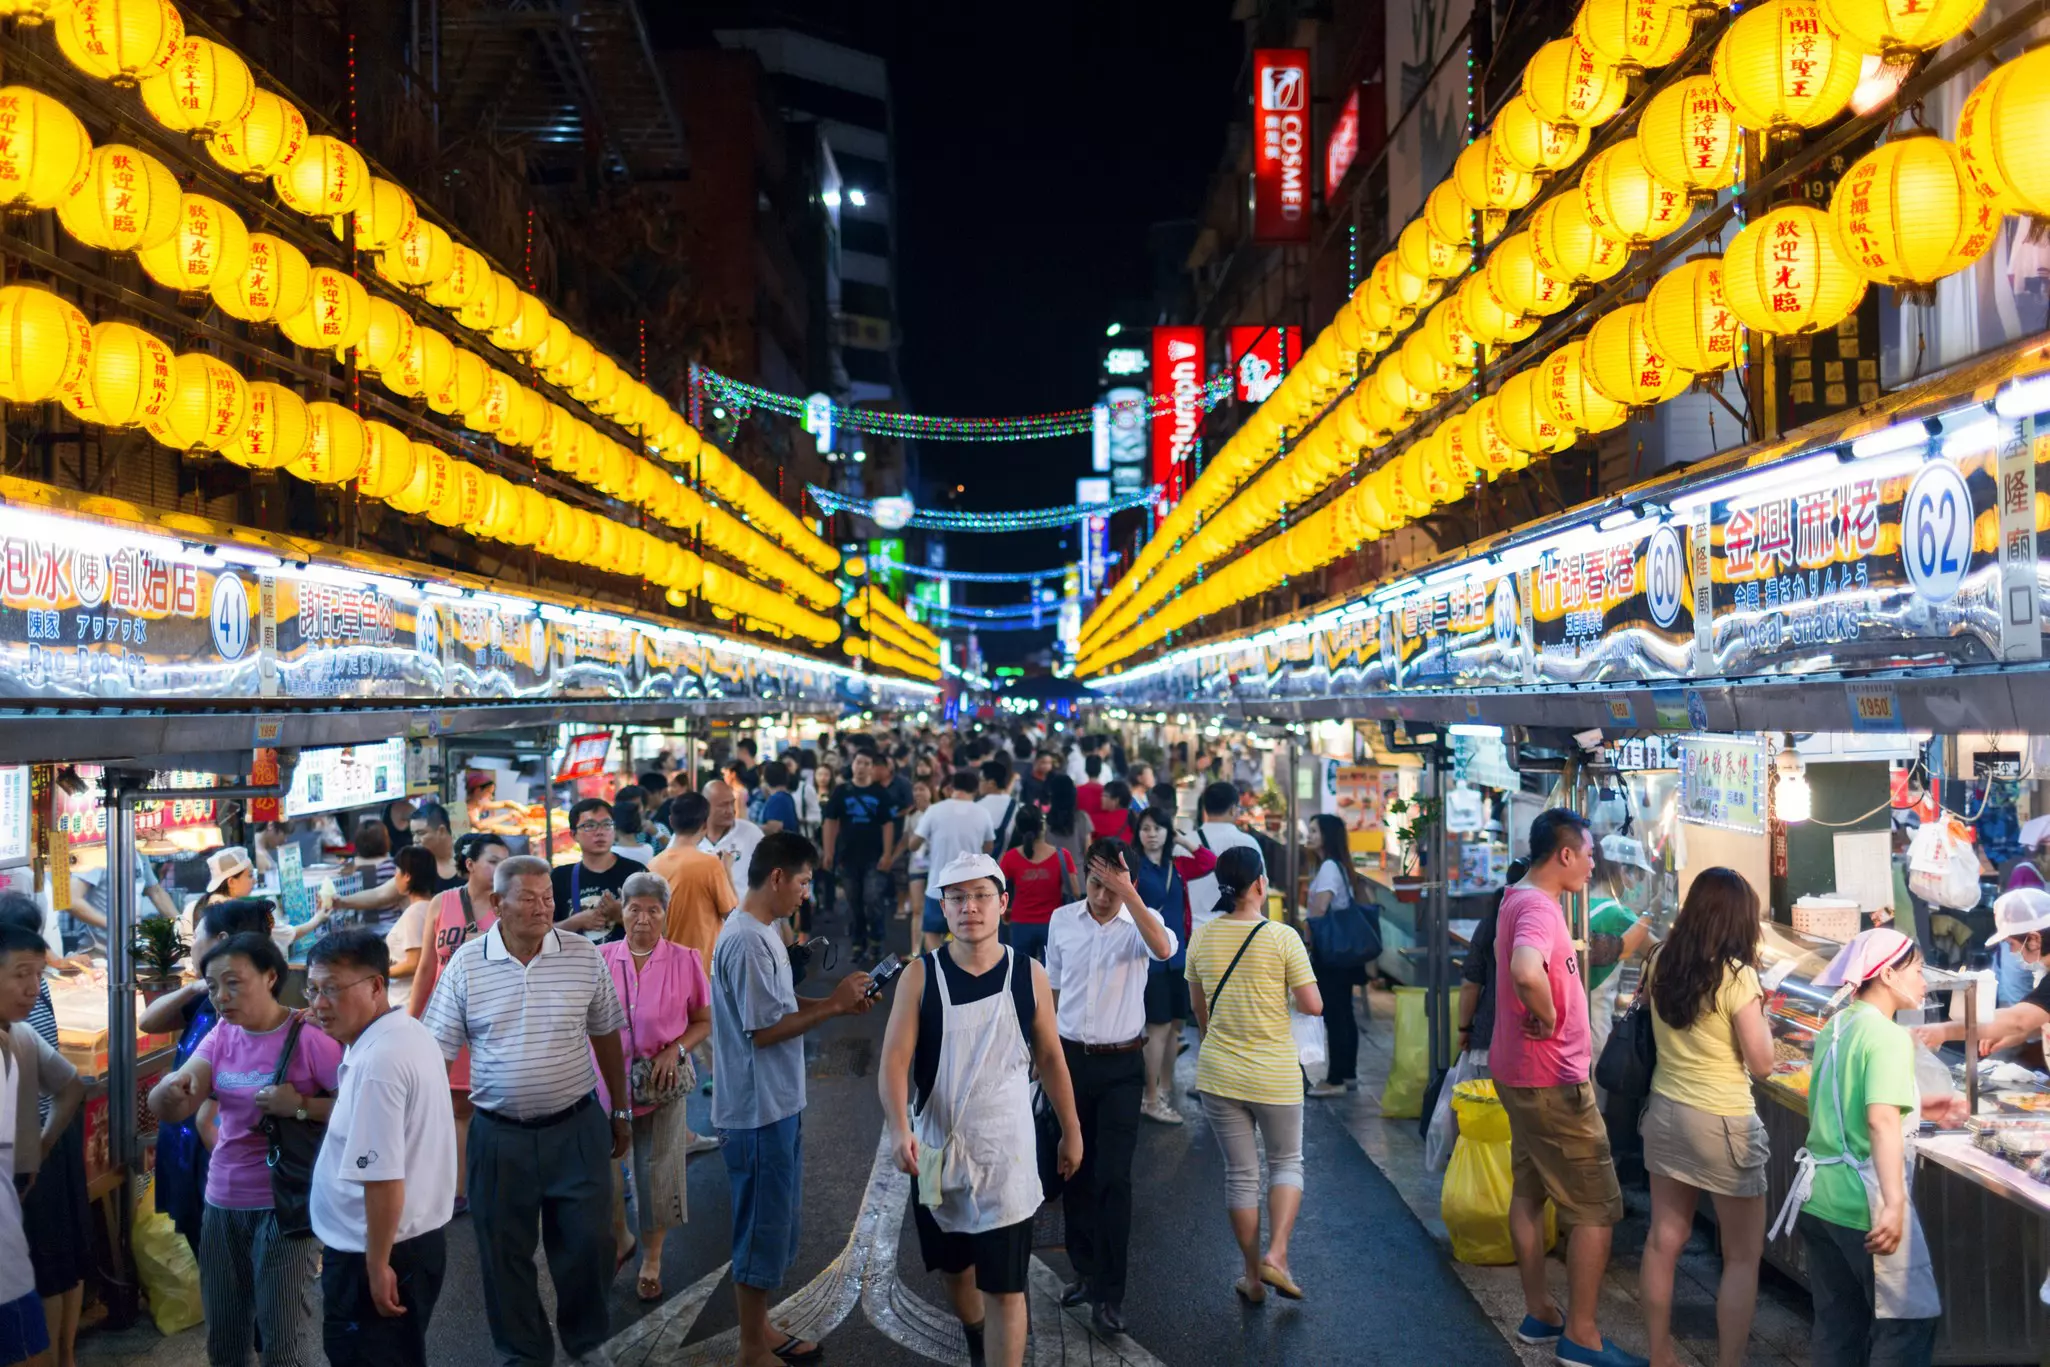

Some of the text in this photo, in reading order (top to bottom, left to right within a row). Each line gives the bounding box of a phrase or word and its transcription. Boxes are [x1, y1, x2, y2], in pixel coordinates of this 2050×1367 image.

[80, 0, 108, 55] 堂十組
[1631, 0, 1656, 46] 販小組
[1785, 19, 1819, 97] 開漳聖王
[1692, 98, 1719, 169] 開漳聖王
[112, 155, 138, 233] 歡迎光臨
[1281, 114, 1302, 221] COSMED
[188, 204, 211, 276] 歡迎光臨
[1850, 163, 1889, 267] 廟口攤販小組
[250, 242, 269, 307] 歡迎光臨
[1772, 220, 1802, 313] 歡迎光臨
[321, 276, 342, 335] 歡迎光臨
[210, 379, 236, 436] 開漳聖王
[1918, 488, 1958, 578] 62
[1654, 543, 1677, 607] 60
[28, 609, 60, 639] 陳家
[219, 591, 242, 645] 41
[421, 615, 434, 653] 39
[1743, 606, 1860, 649] local snacks
